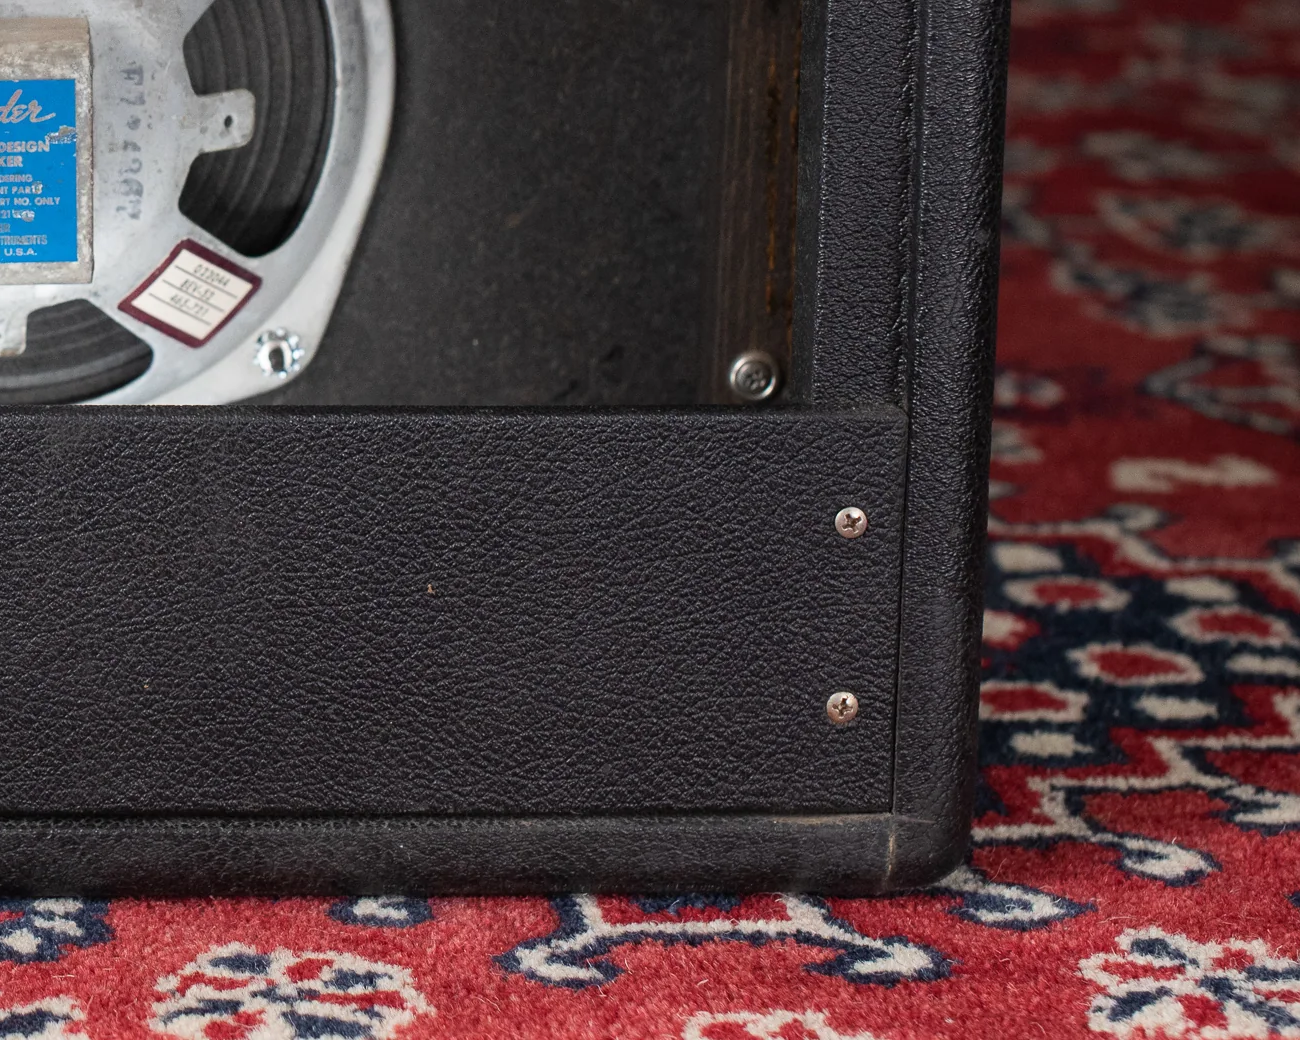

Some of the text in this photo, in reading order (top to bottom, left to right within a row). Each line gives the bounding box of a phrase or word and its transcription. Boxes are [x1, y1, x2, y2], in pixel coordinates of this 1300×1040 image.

[14, 197, 32, 206] NO.
[34, 196, 60, 206] ONLY
[3, 247, 38, 257] U.S.A.
